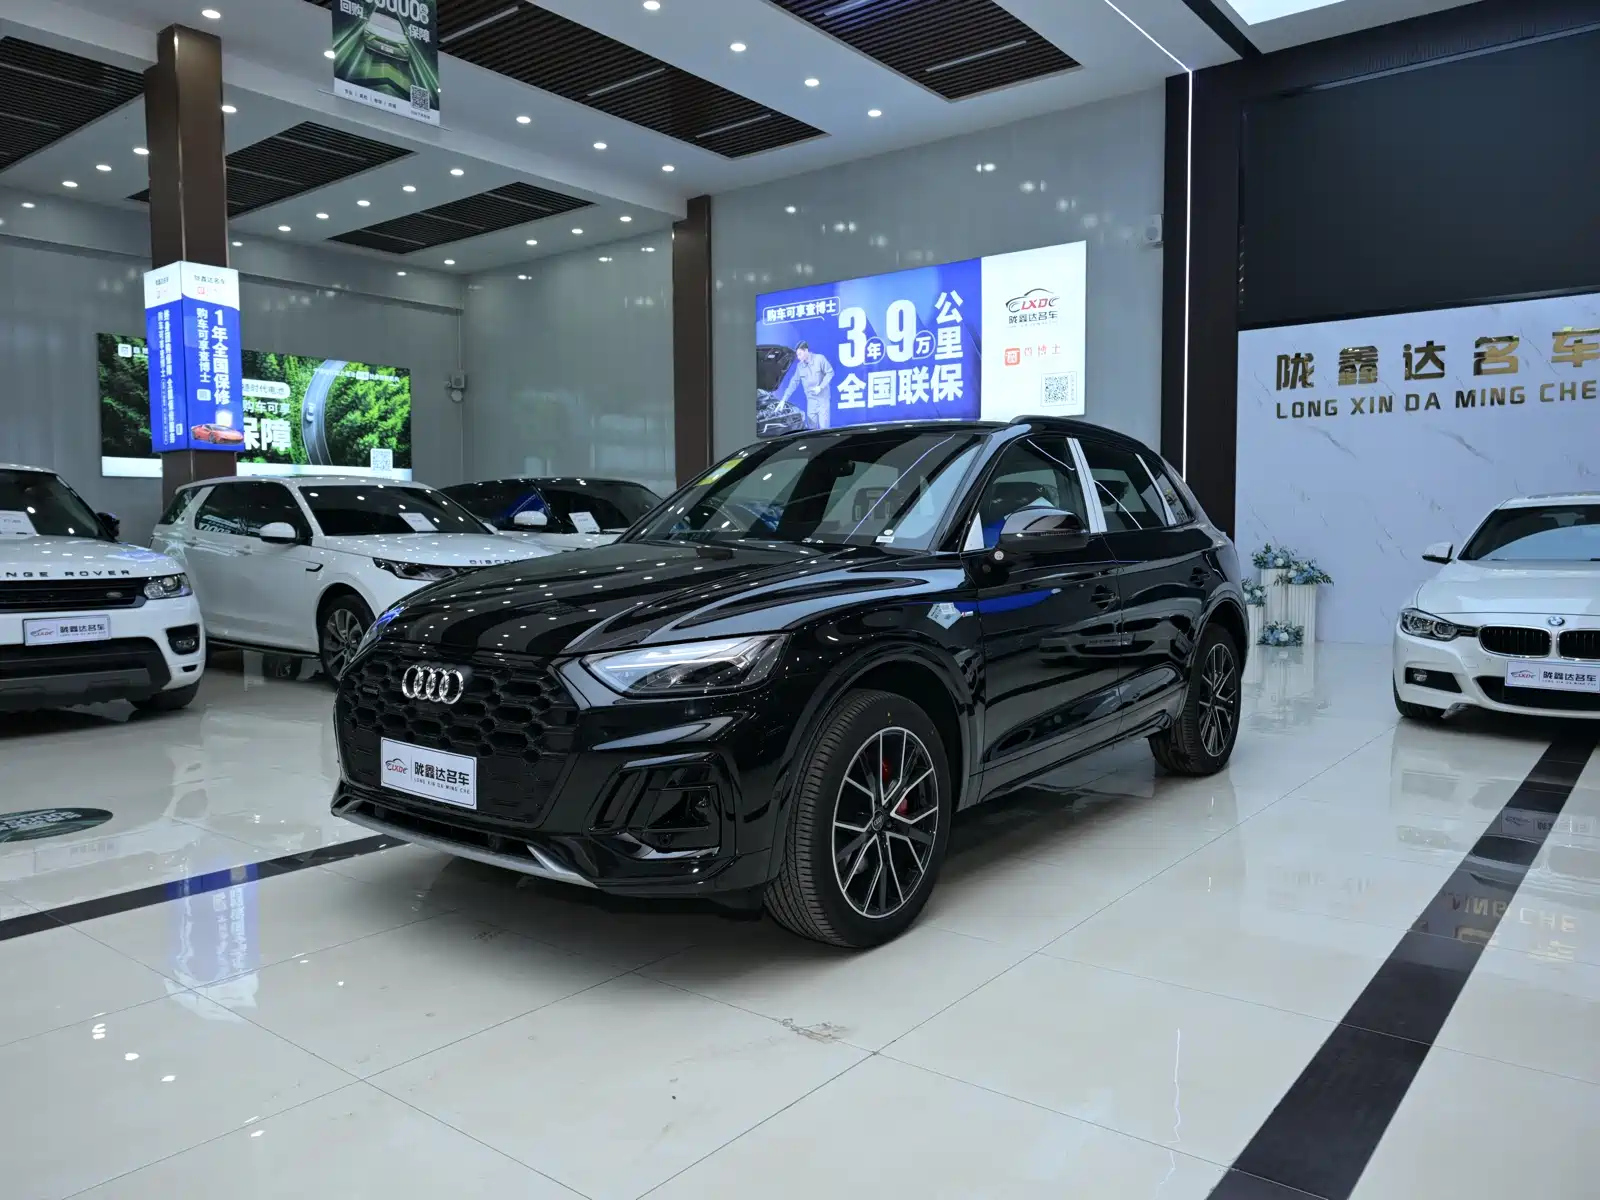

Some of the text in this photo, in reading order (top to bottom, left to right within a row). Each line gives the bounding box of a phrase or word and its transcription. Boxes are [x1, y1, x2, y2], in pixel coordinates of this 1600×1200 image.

[408, 24, 430, 43] 保障
[766, 299, 836, 322] 购车可享查博士
[196, 308, 211, 383] 购车可享查博士
[211, 309, 230, 405] 1年全国保修
[1276, 327, 1600, 391] 陇鑫达名车
[243, 400, 291, 415] 购车可享
[837, 363, 963, 410] 全国联保
[1276, 380, 1597, 419] LONG XIN DA MING CHE
